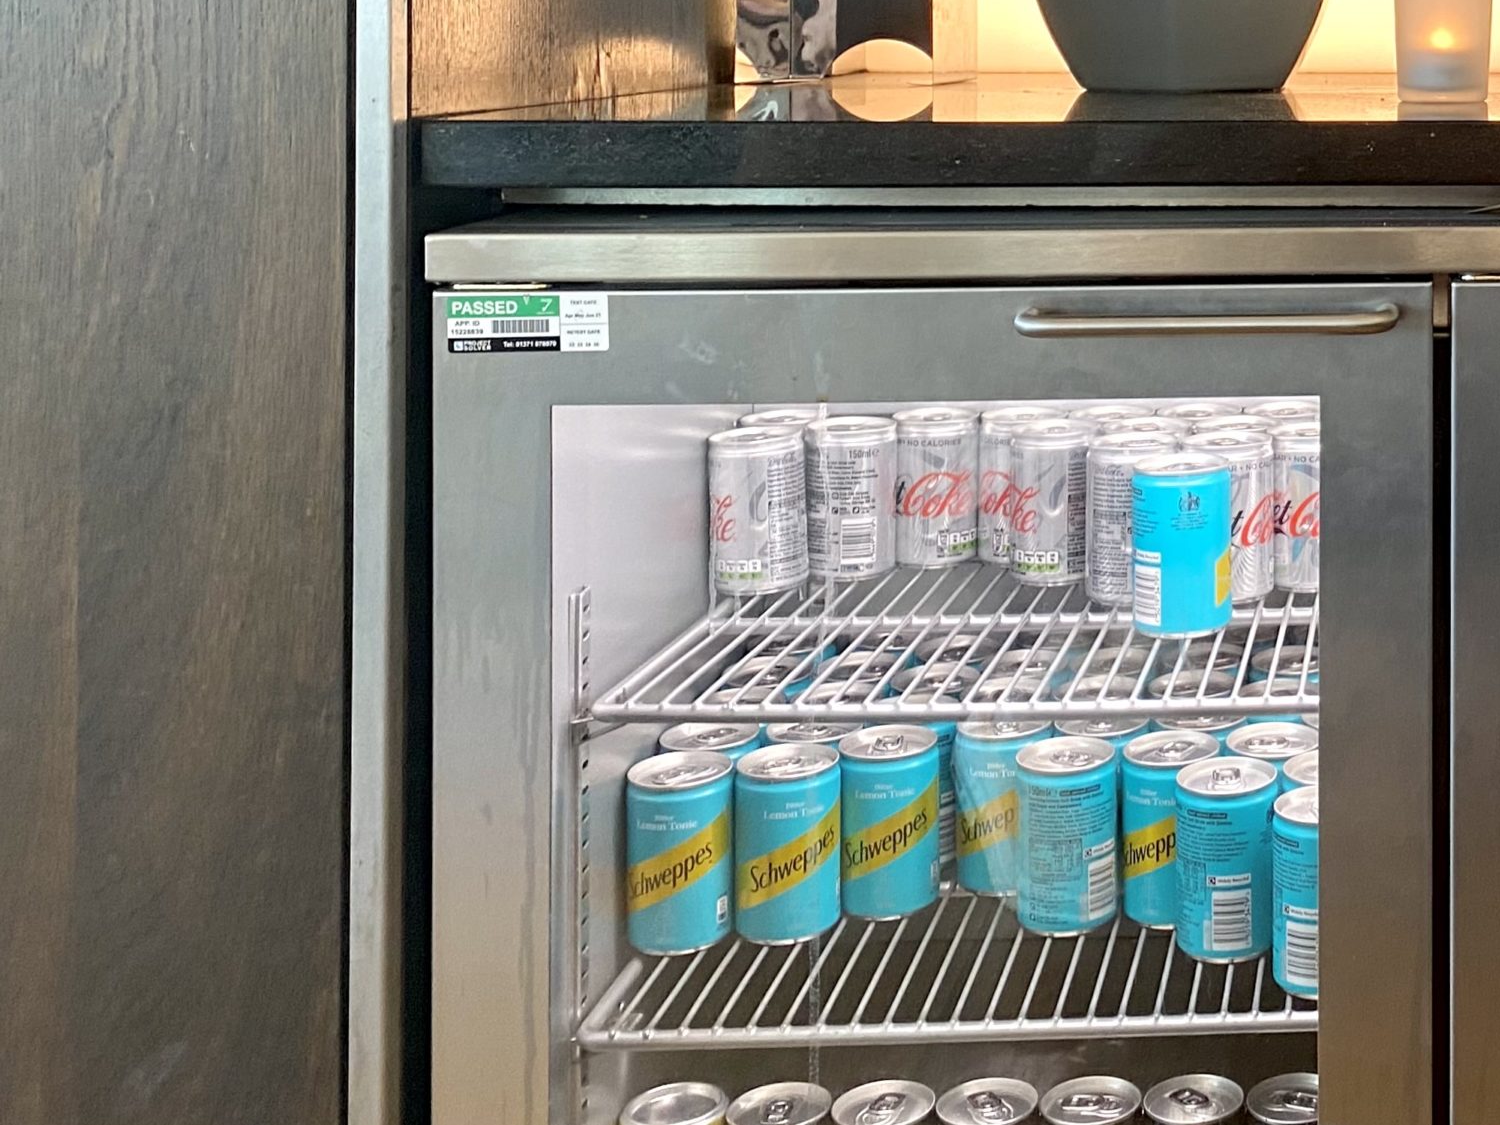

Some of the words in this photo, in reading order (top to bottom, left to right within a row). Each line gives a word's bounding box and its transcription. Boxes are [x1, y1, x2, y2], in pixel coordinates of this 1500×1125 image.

[452, 301, 518, 315] PASSED
[750, 825, 835, 893] Schweppes
[845, 808, 927, 868] Schweppes
[629, 842, 712, 899] Schweppes
